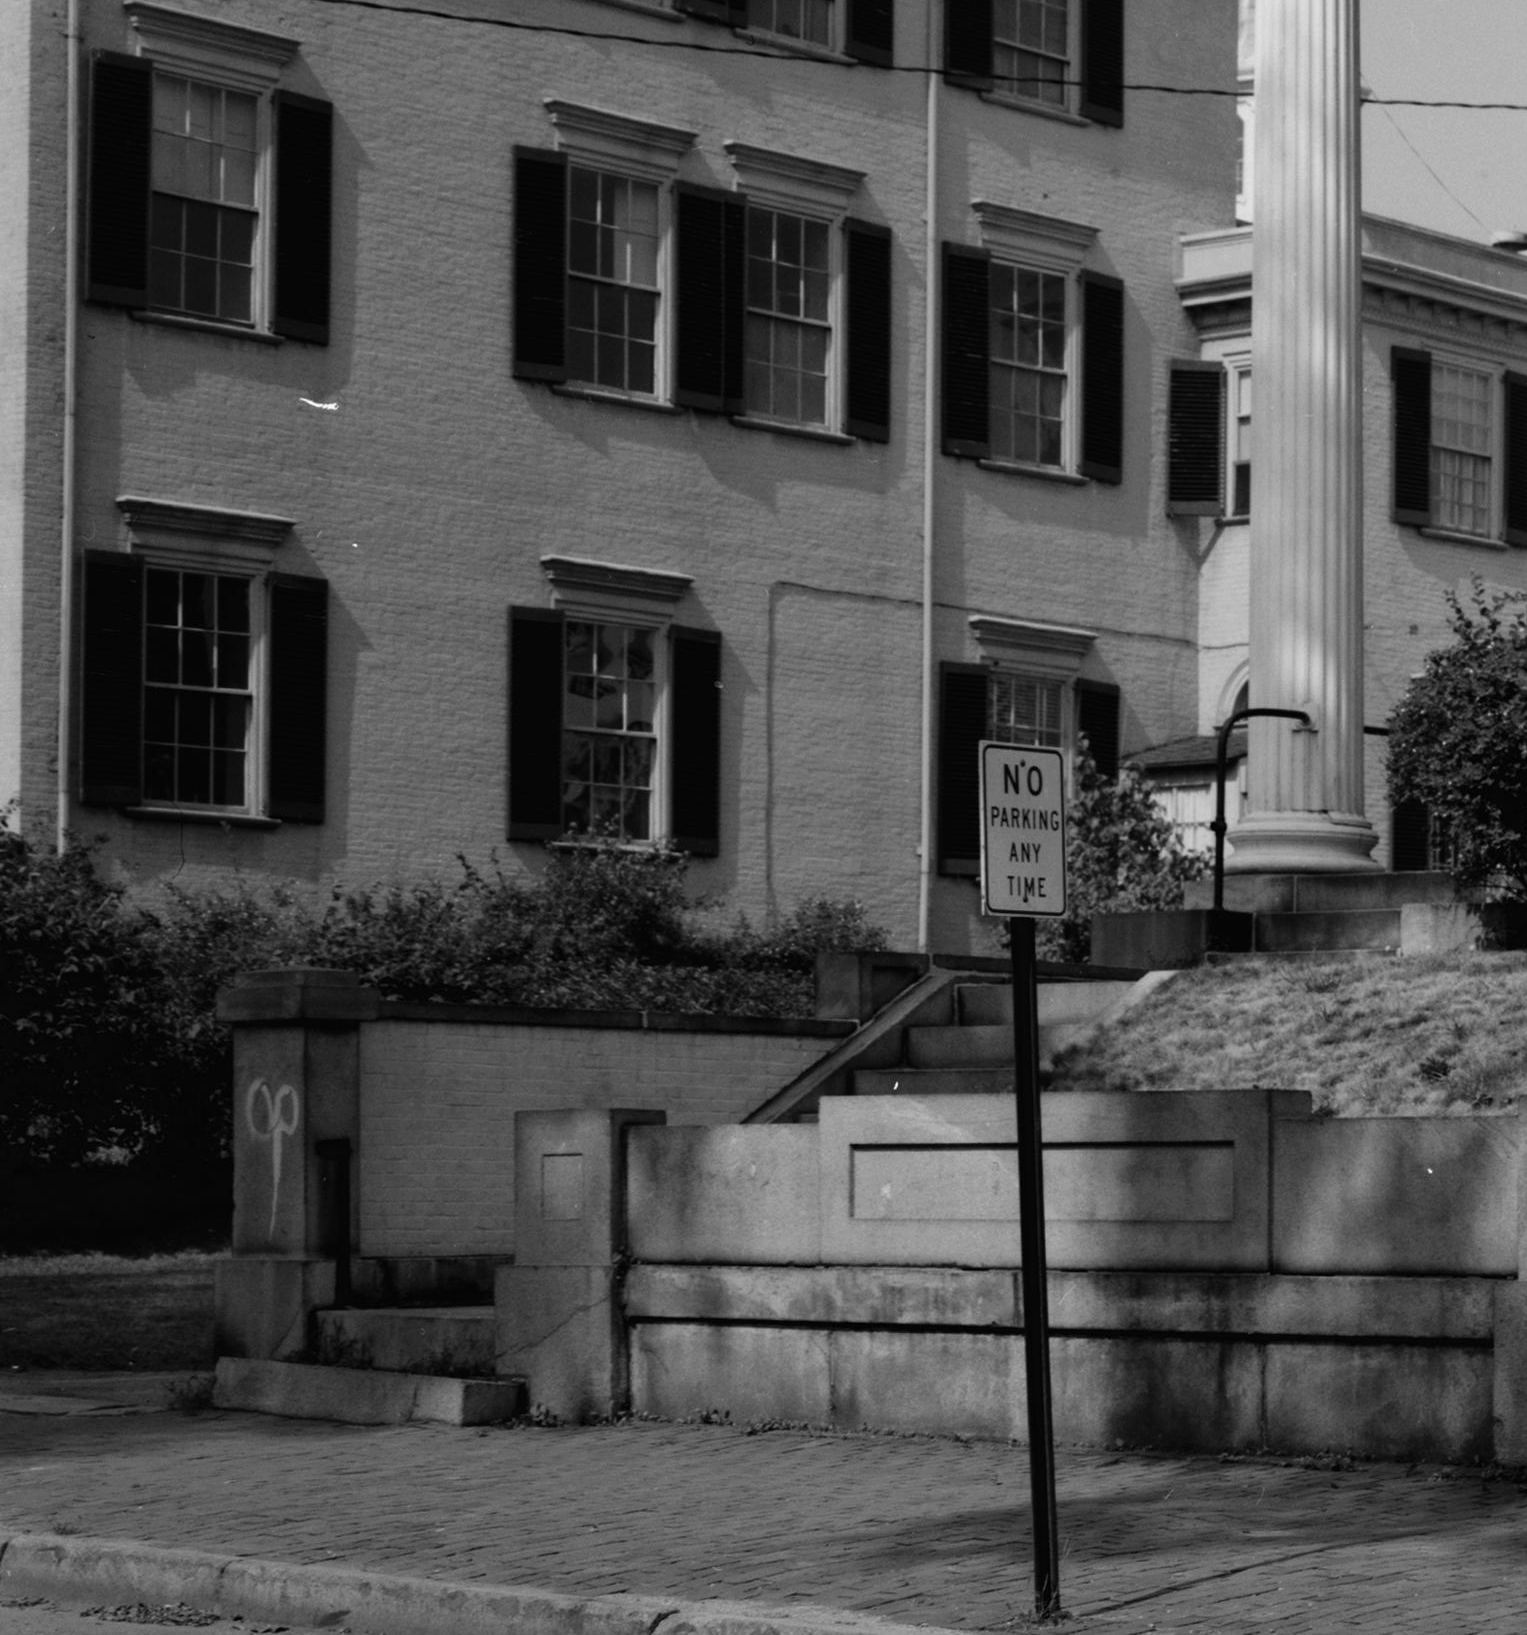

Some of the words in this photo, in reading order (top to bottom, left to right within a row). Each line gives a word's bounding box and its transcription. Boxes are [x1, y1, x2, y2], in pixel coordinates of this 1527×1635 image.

[1003, 764, 1043, 796] NO
[991, 806, 1060, 831] PARKING
[1009, 843, 1041, 863] ANY
[1007, 875, 1046, 898] TIME
